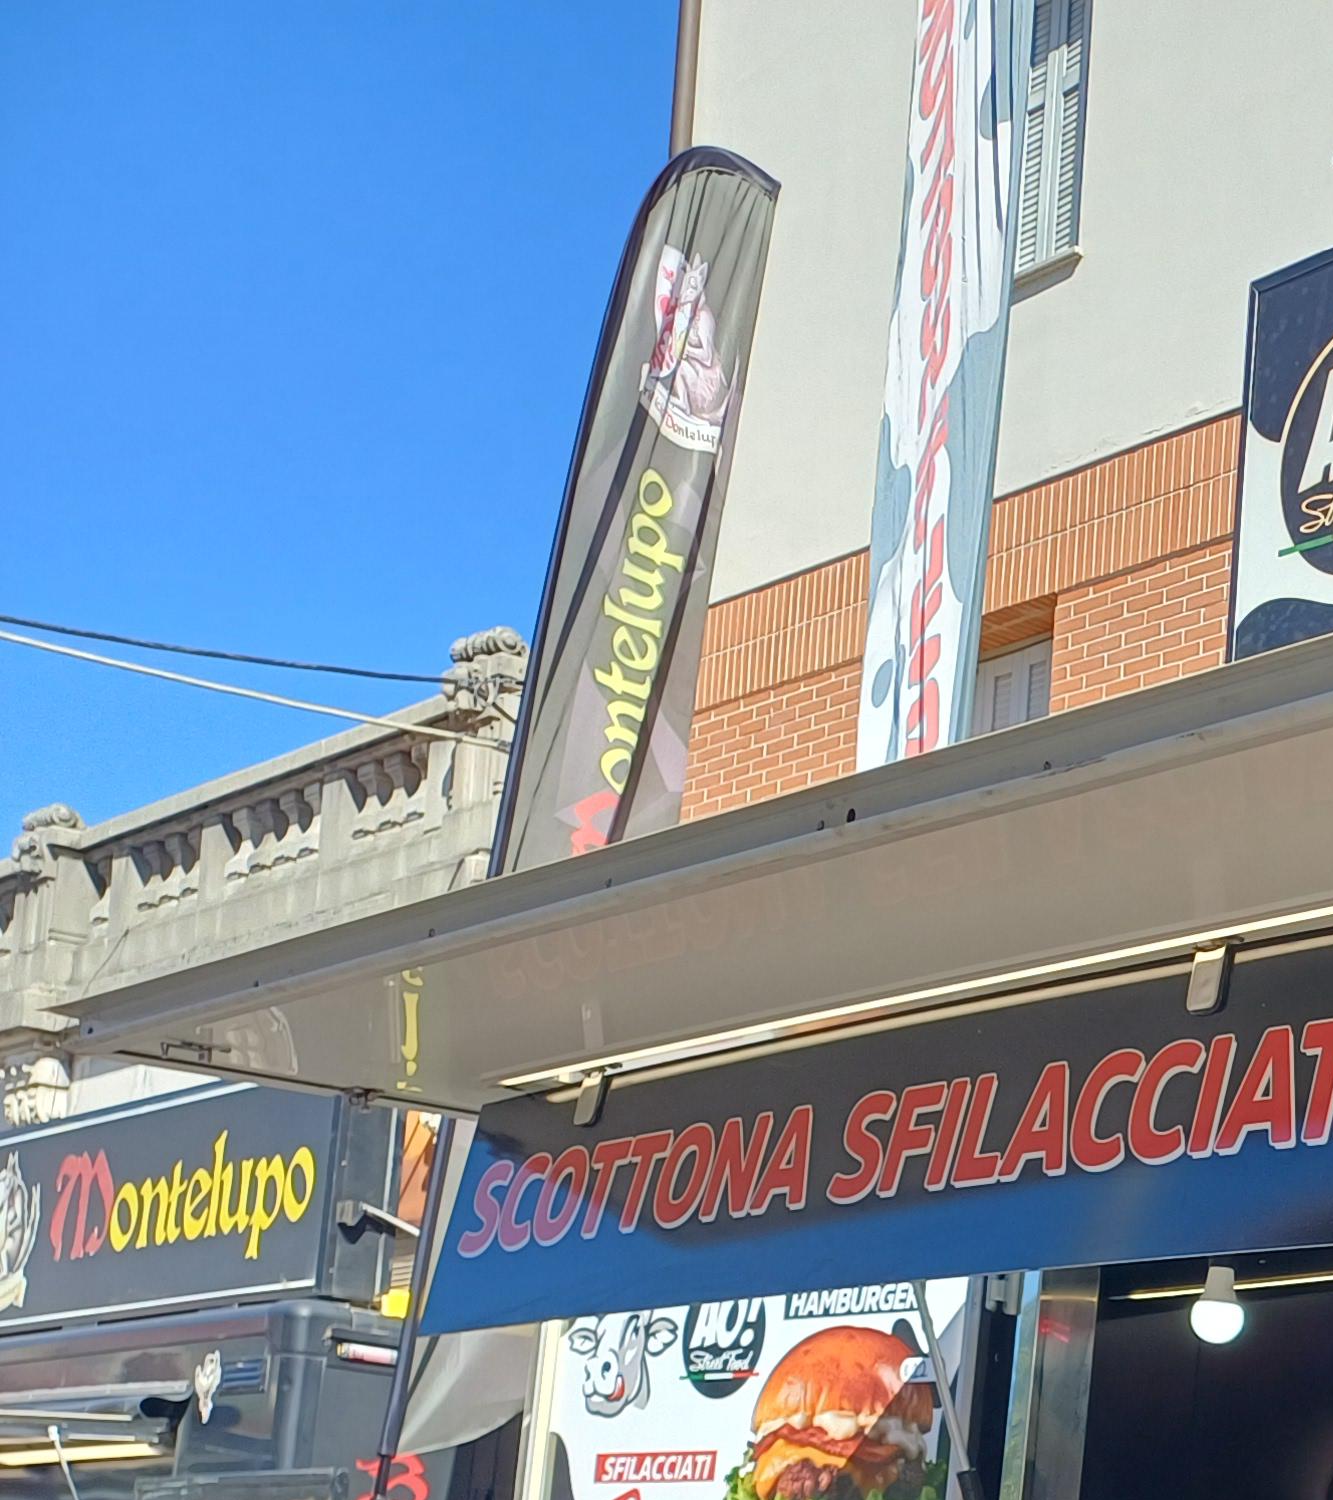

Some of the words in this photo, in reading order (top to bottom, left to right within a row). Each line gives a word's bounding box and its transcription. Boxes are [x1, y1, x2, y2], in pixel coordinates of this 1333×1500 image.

[50, 1129, 315, 1262] Montelupo
[457, 1104, 809, 1259] SCOTTONA
[601, 1454, 713, 1481] SFILACCIATI
